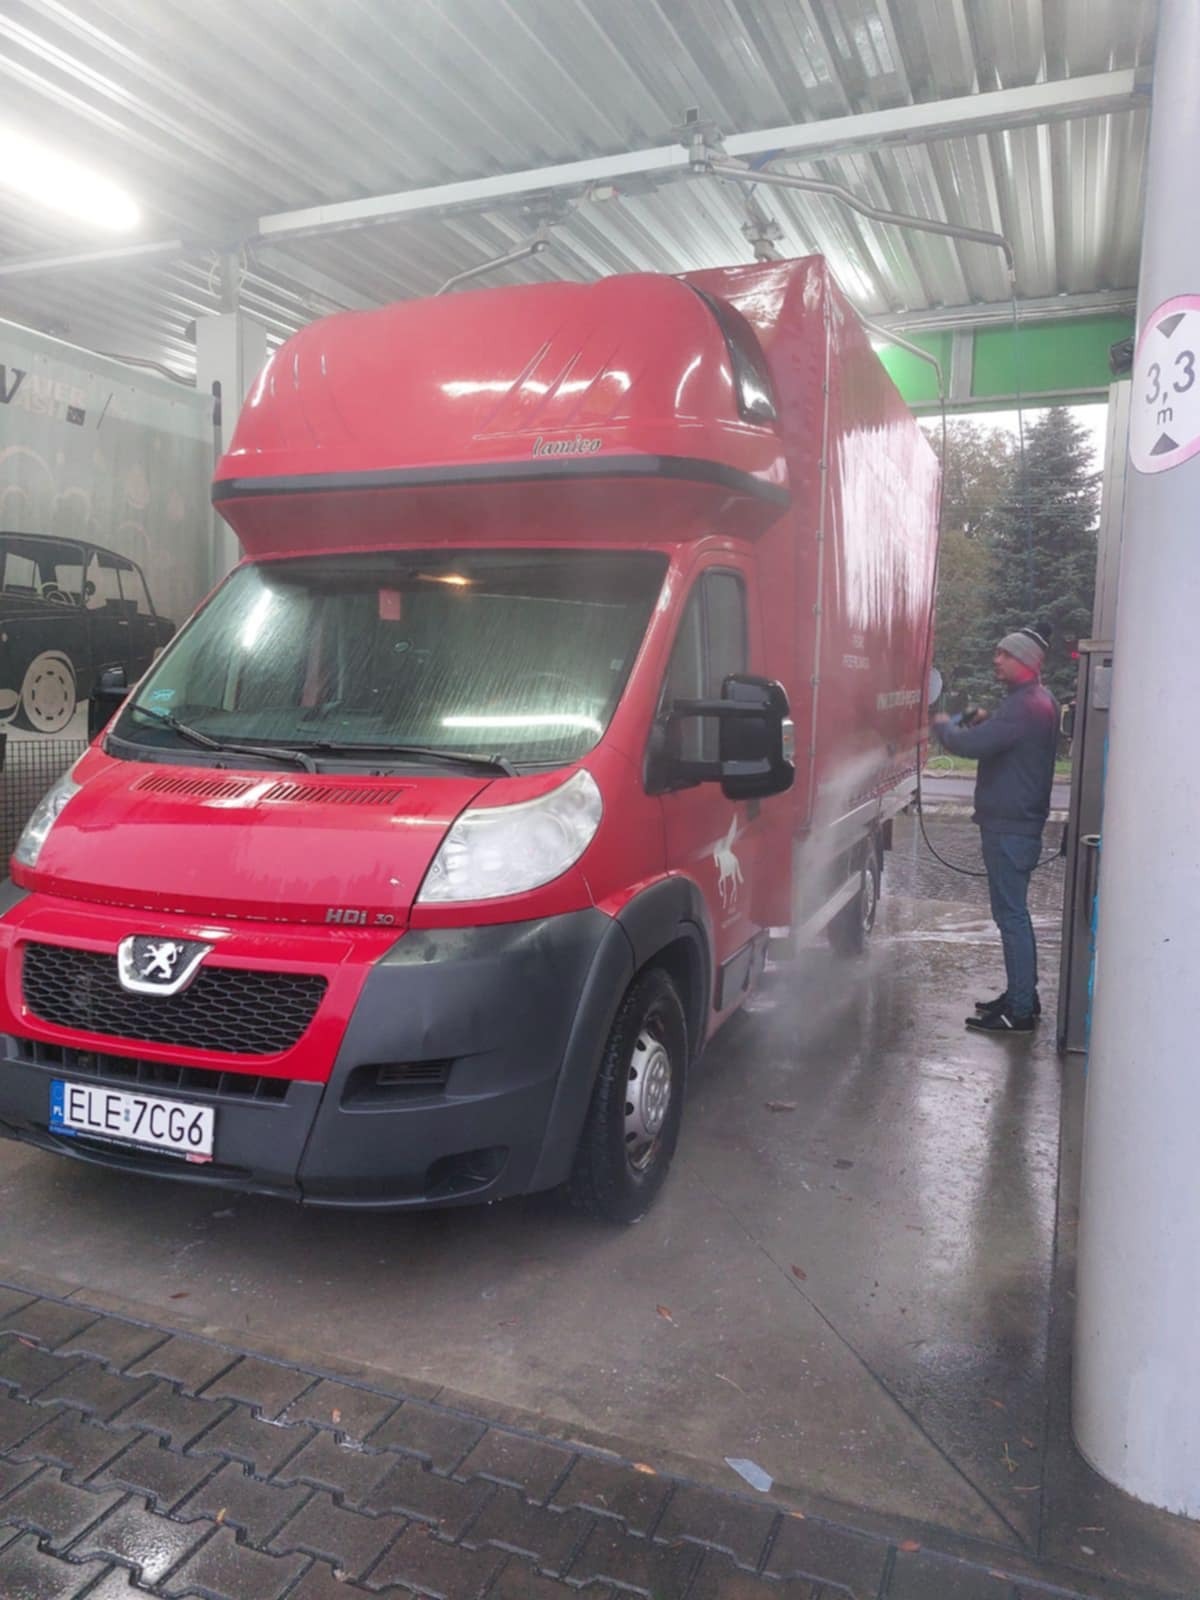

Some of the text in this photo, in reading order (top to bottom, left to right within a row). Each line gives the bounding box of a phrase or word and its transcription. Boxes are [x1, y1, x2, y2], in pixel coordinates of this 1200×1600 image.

[1145, 350, 1196, 404] 3,3
[1157, 407, 1173, 424] m
[70, 1088, 121, 1131] ELE
[132, 1099, 203, 1146] 7CG6
